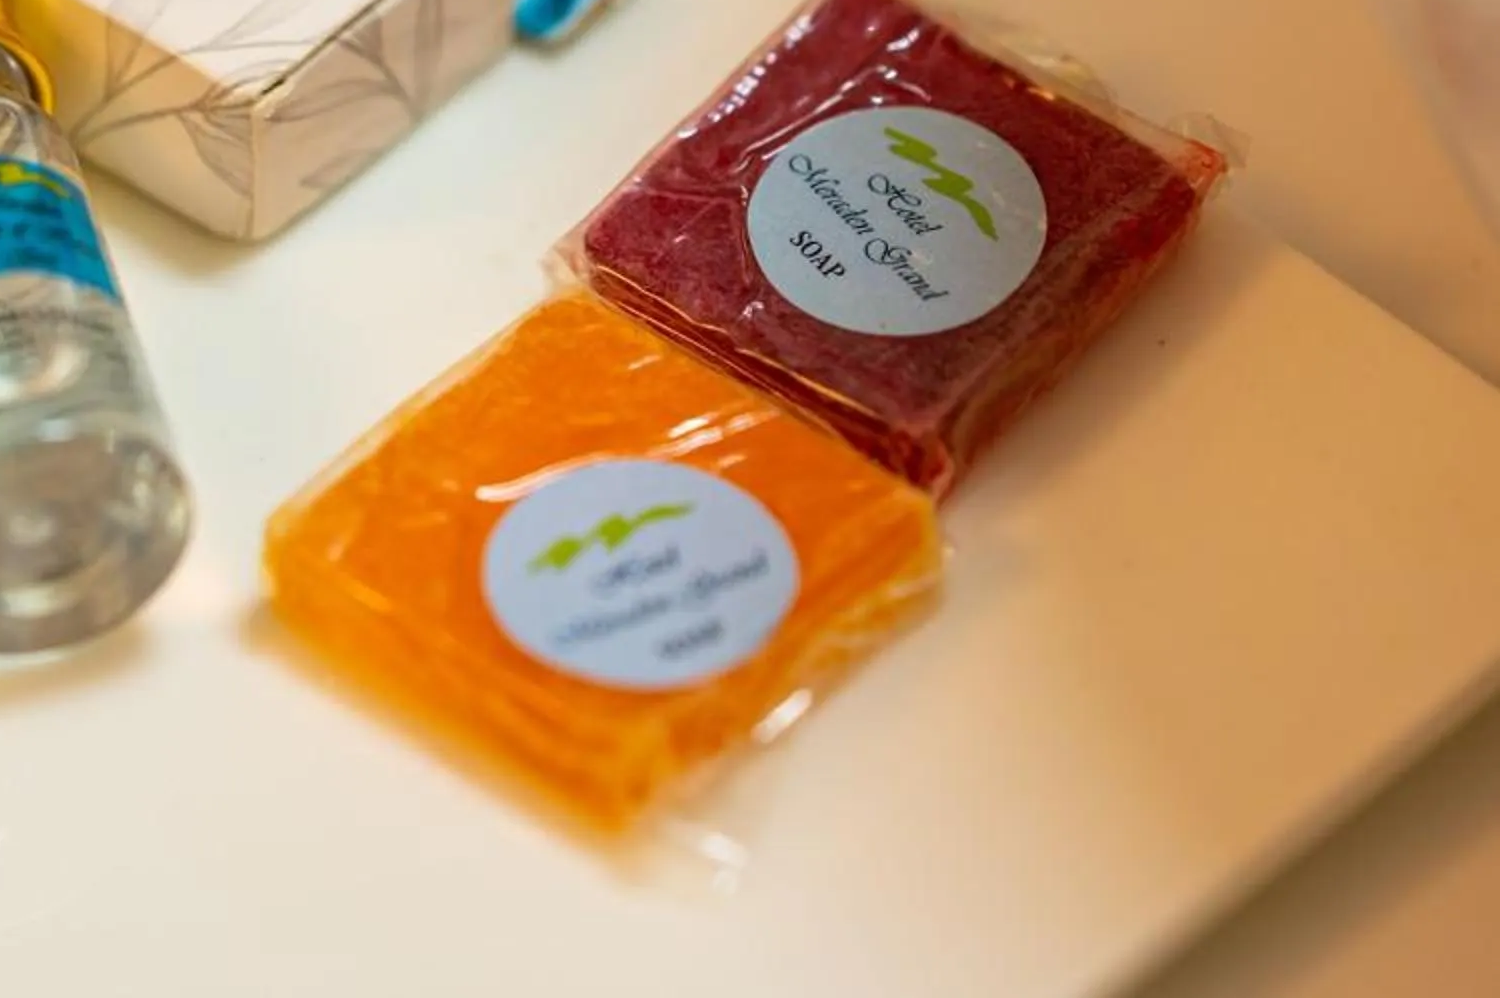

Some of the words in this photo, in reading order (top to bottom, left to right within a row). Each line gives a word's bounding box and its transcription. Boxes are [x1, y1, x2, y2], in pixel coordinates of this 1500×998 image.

[787, 153, 875, 236] Meraden
[863, 237, 950, 302] Grand
[866, 172, 944, 236] Hotel
[788, 229, 847, 280] SOAP
